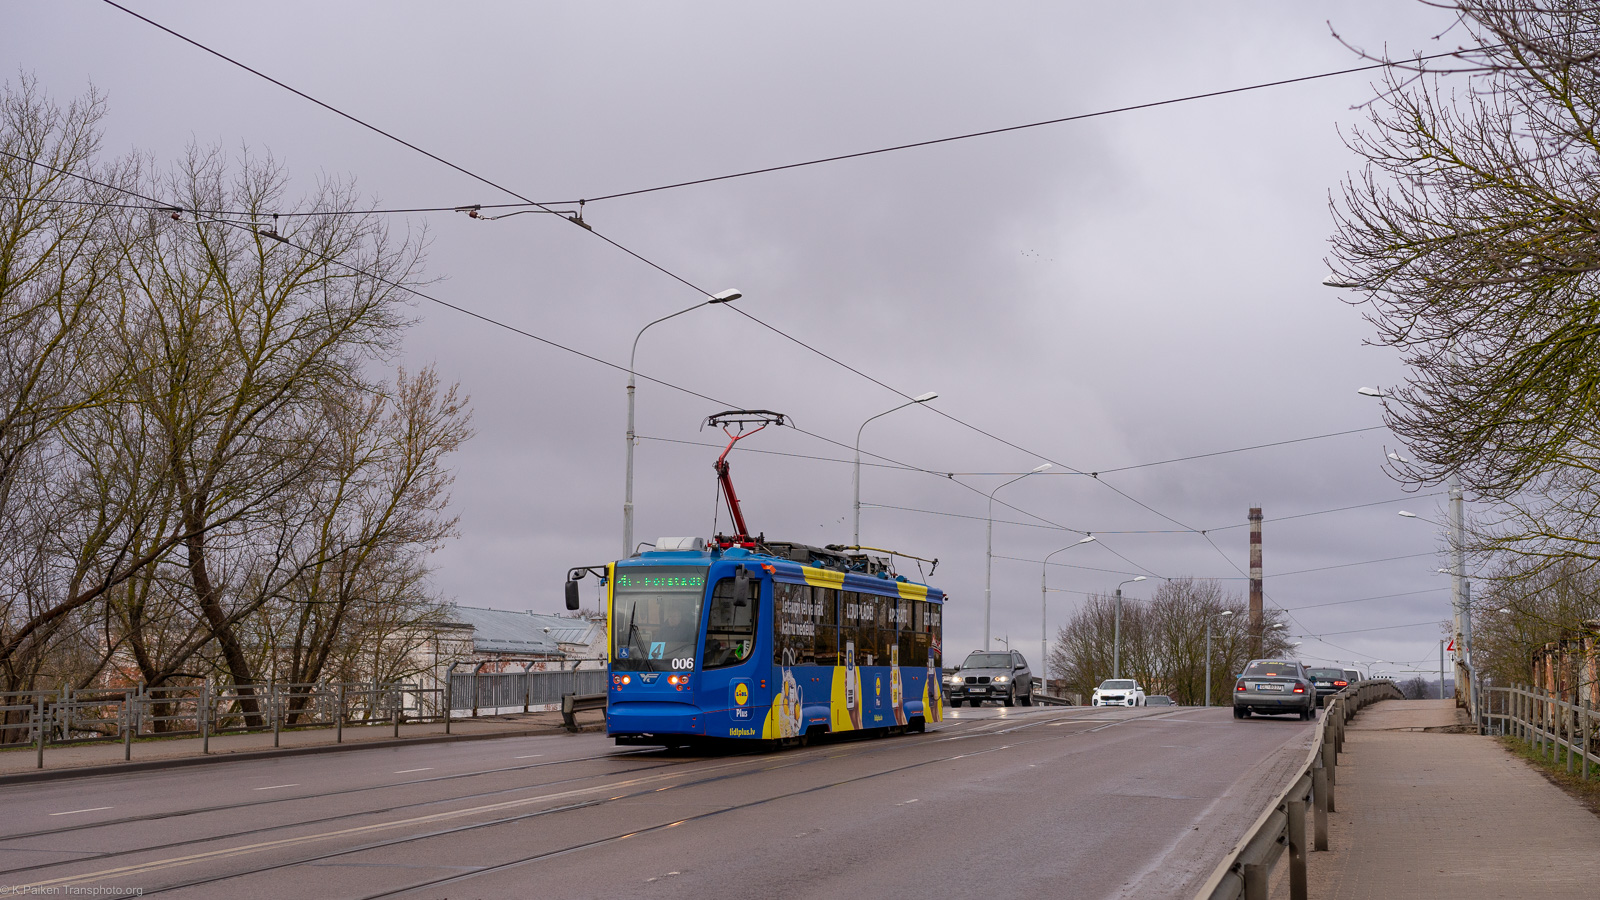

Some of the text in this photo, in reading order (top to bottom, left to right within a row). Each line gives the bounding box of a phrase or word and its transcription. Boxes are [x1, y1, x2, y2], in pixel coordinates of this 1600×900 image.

[651, 643, 662, 659] 4
[671, 657, 694, 670] 006
[736, 708, 748, 717] Plus
[729, 727, 756, 738] lidlplus.lv
